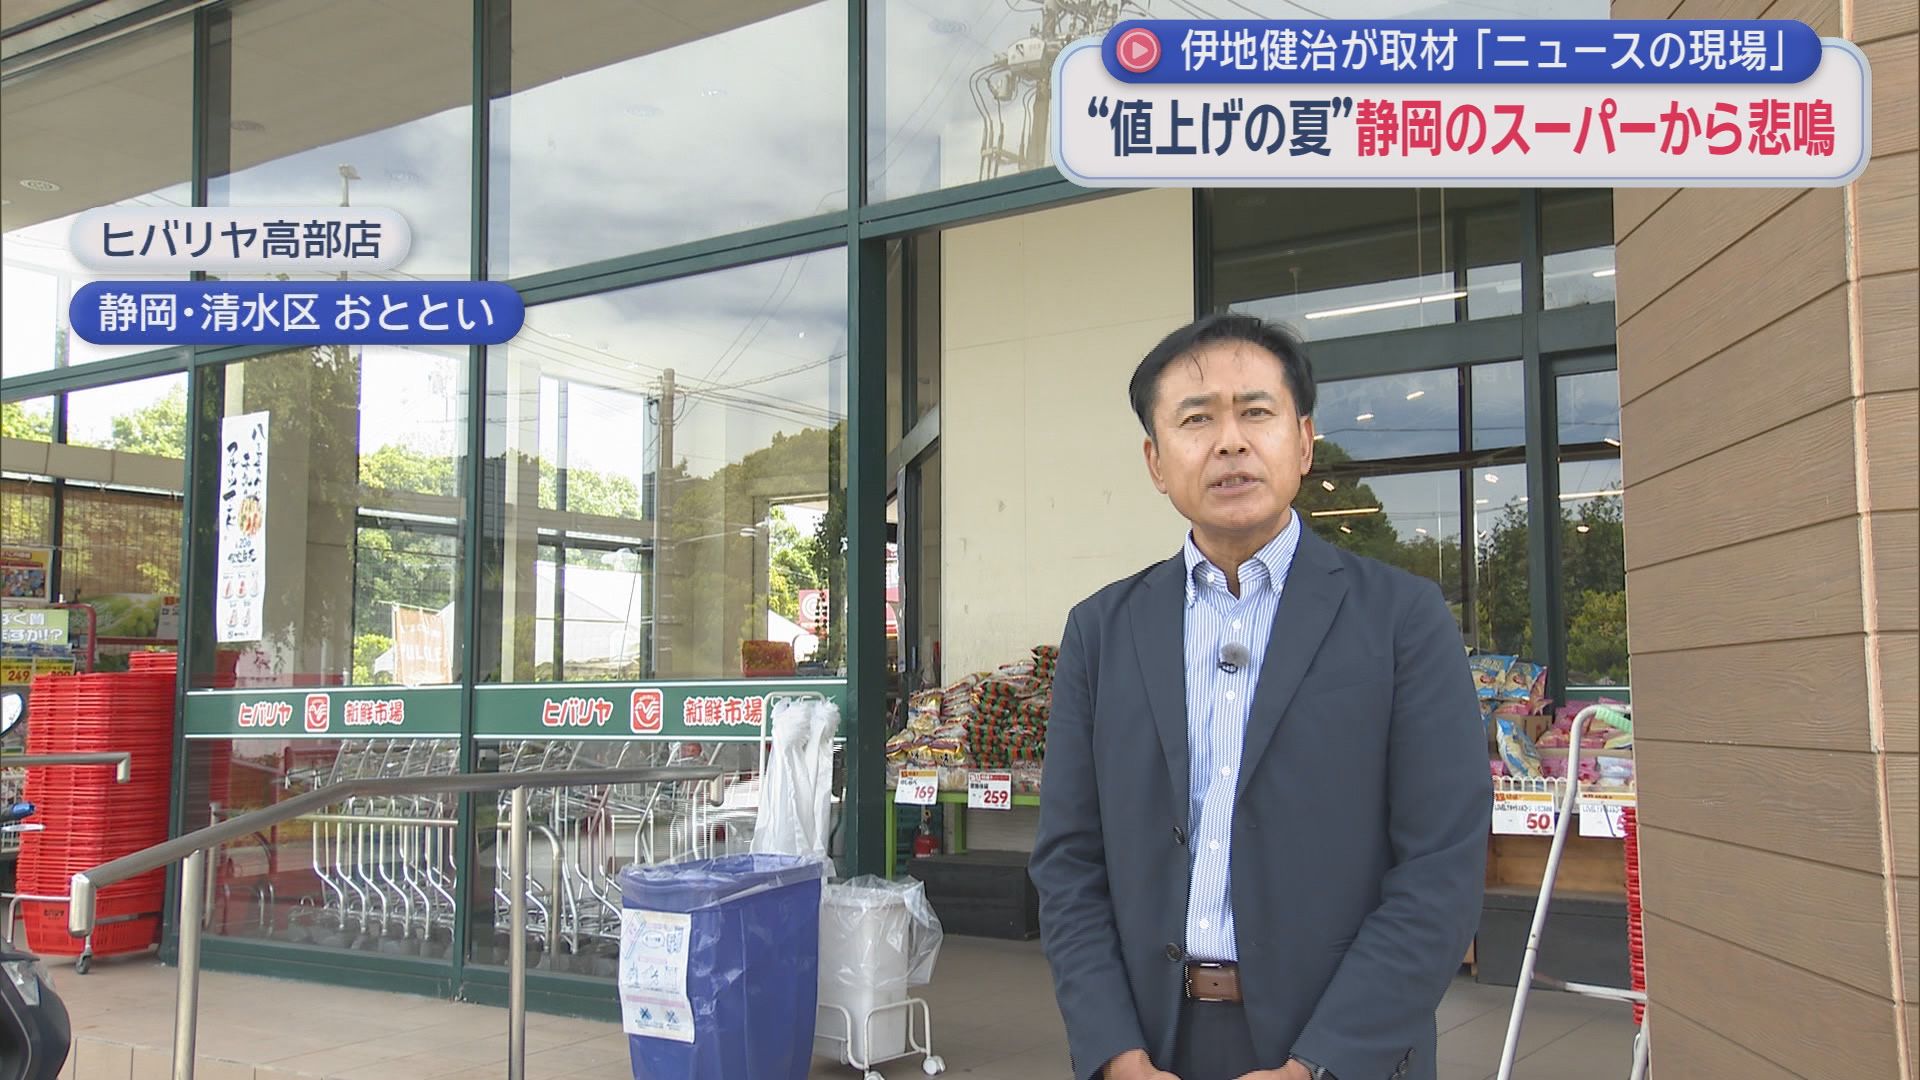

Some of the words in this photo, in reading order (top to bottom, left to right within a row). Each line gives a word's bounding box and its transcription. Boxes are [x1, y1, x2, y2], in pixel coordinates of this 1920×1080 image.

[8, 670, 30, 681] 249
[238, 701, 293, 727] ヒバリヤ
[344, 699, 405, 726] 新鮮市場
[542, 697, 614, 727] ヒバリヤ
[683, 695, 763, 726] 新鮮市場
[914, 786, 936, 799] 169
[983, 790, 1009, 804] 259
[1527, 813, 1550, 829] 50
